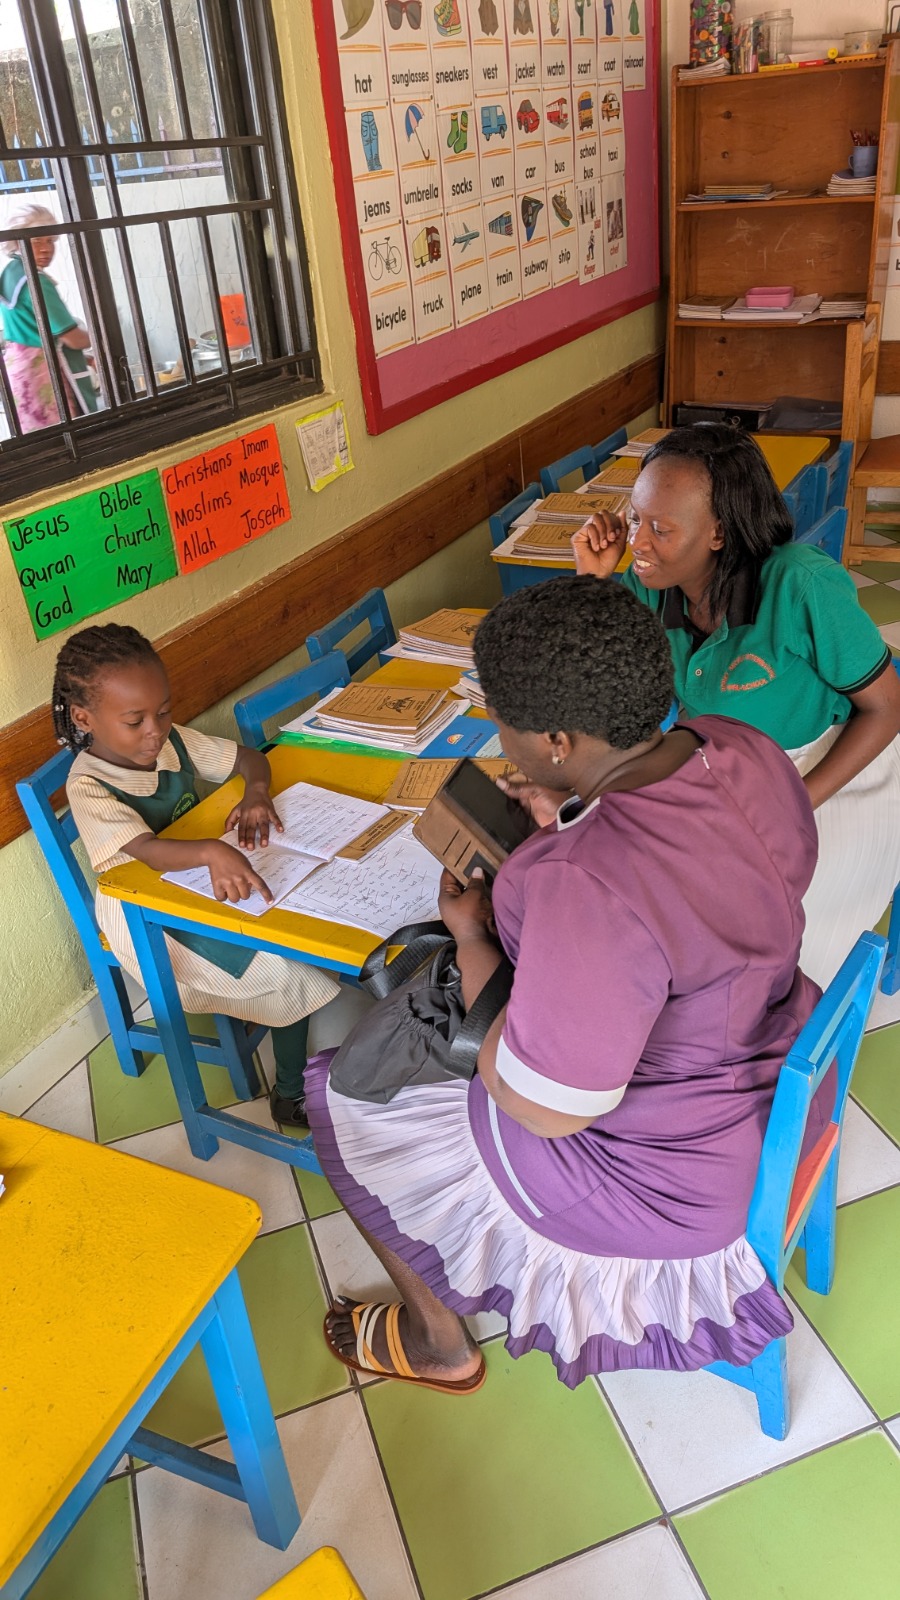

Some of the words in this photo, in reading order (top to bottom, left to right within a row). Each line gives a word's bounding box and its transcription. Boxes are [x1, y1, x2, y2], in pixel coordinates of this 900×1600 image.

[546, 60, 566, 76] watch
[577, 59, 591, 74] scarf
[604, 58, 616, 71] coat
[624, 55, 644, 69] raincoat
[391, 69, 430, 87] sunglasses
[435, 66, 469, 84] sneakers
[482, 64, 498, 80] vest
[515, 62, 536, 83] jacket
[354, 74, 373, 93] hat
[580, 142, 597, 159] school
[608, 147, 618, 162] taxi
[525, 166, 536, 179] car
[554, 160, 565, 173] bus
[583, 166, 594, 180] bus
[451, 177, 473, 197] socks
[491, 175, 505, 188] van
[404, 184, 439, 205] umbrella
[363, 200, 391, 222] jeans
[558, 248, 571, 265] ship
[524, 259, 549, 277] subway
[496, 268, 513, 287] train
[460, 283, 482, 306] plane
[422, 294, 444, 315] truck
[375, 306, 407, 331] bicycle
[165, 451, 233, 495] Christians
[242, 438, 269, 461] Imam
[174, 490, 233, 529] Moslims
[239, 460, 280, 489] Mosque
[10, 514, 70, 552] Jesus
[99, 482, 143, 519] Bible
[182, 528, 217, 565] Allah
[240, 493, 286, 539] Joseph
[19, 553, 76, 588] Quran
[104, 508, 161, 554] Church
[35, 585, 74, 629] God
[116, 561, 153, 591] Mary
